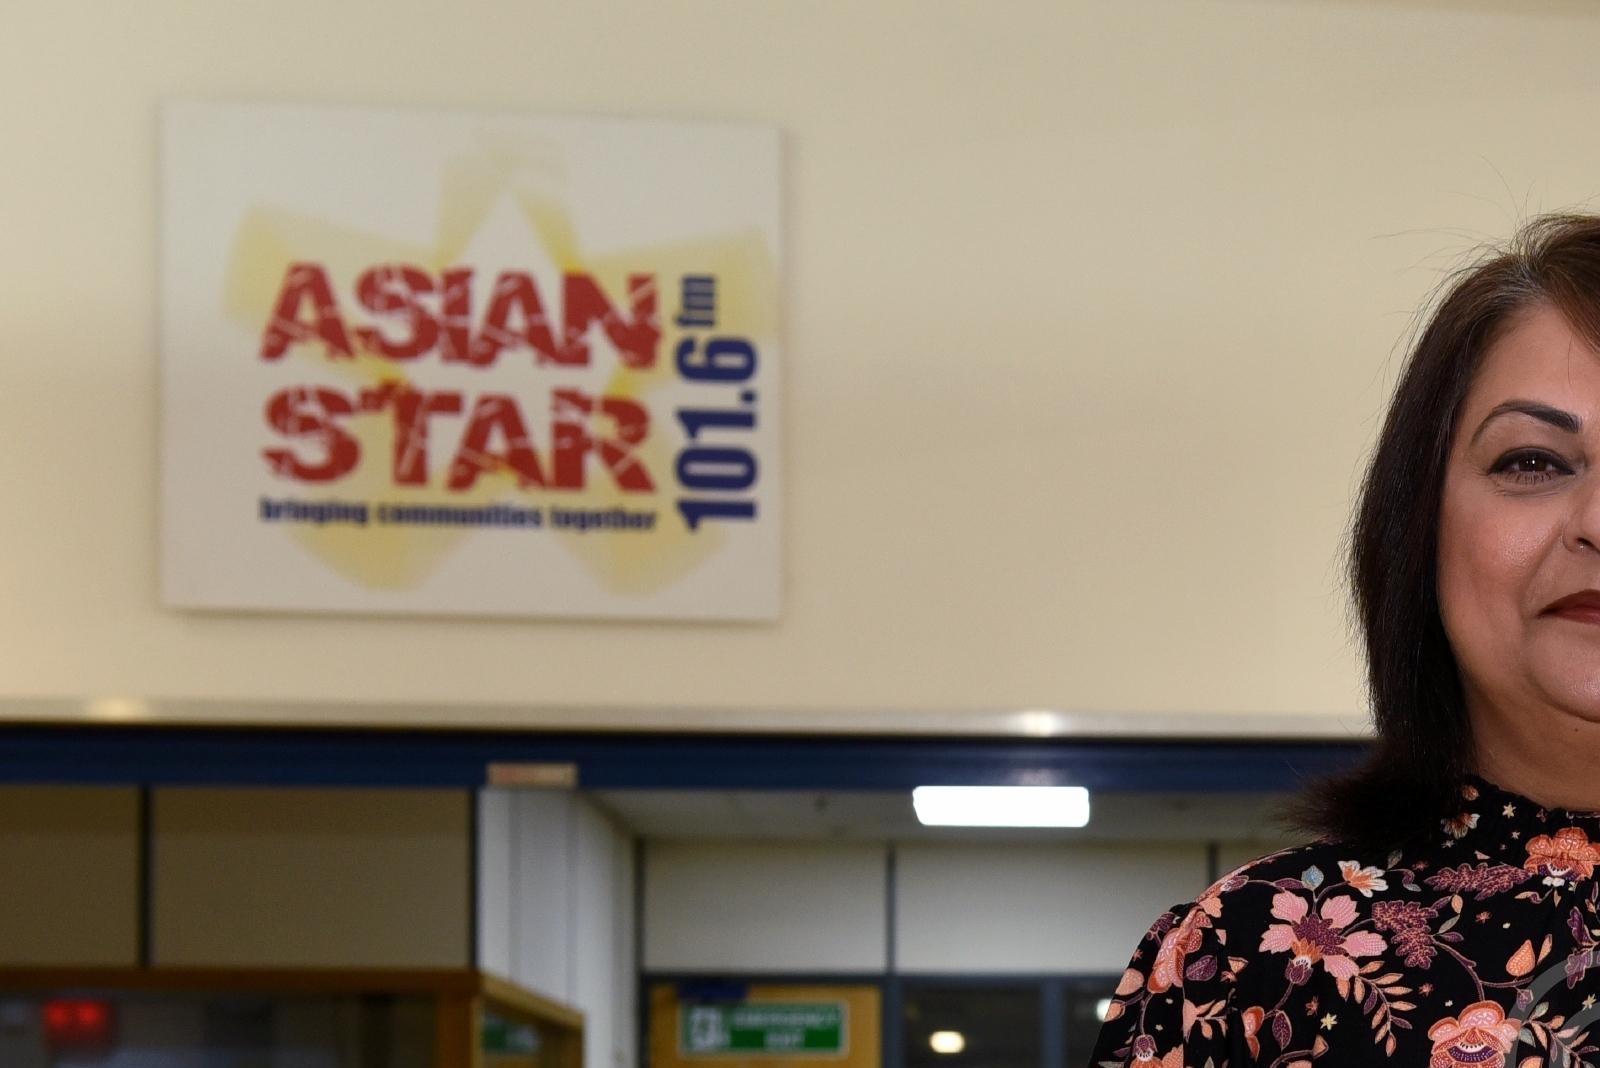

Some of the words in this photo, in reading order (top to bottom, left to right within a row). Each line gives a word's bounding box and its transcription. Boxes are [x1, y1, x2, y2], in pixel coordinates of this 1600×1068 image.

[260, 262, 663, 370] ASIAN
[676, 275, 717, 328] fm
[261, 378, 657, 495] STAR
[674, 335, 759, 531] 101.6
[259, 497, 369, 526] bringing
[376, 502, 544, 529] communities
[550, 507, 657, 533] together
